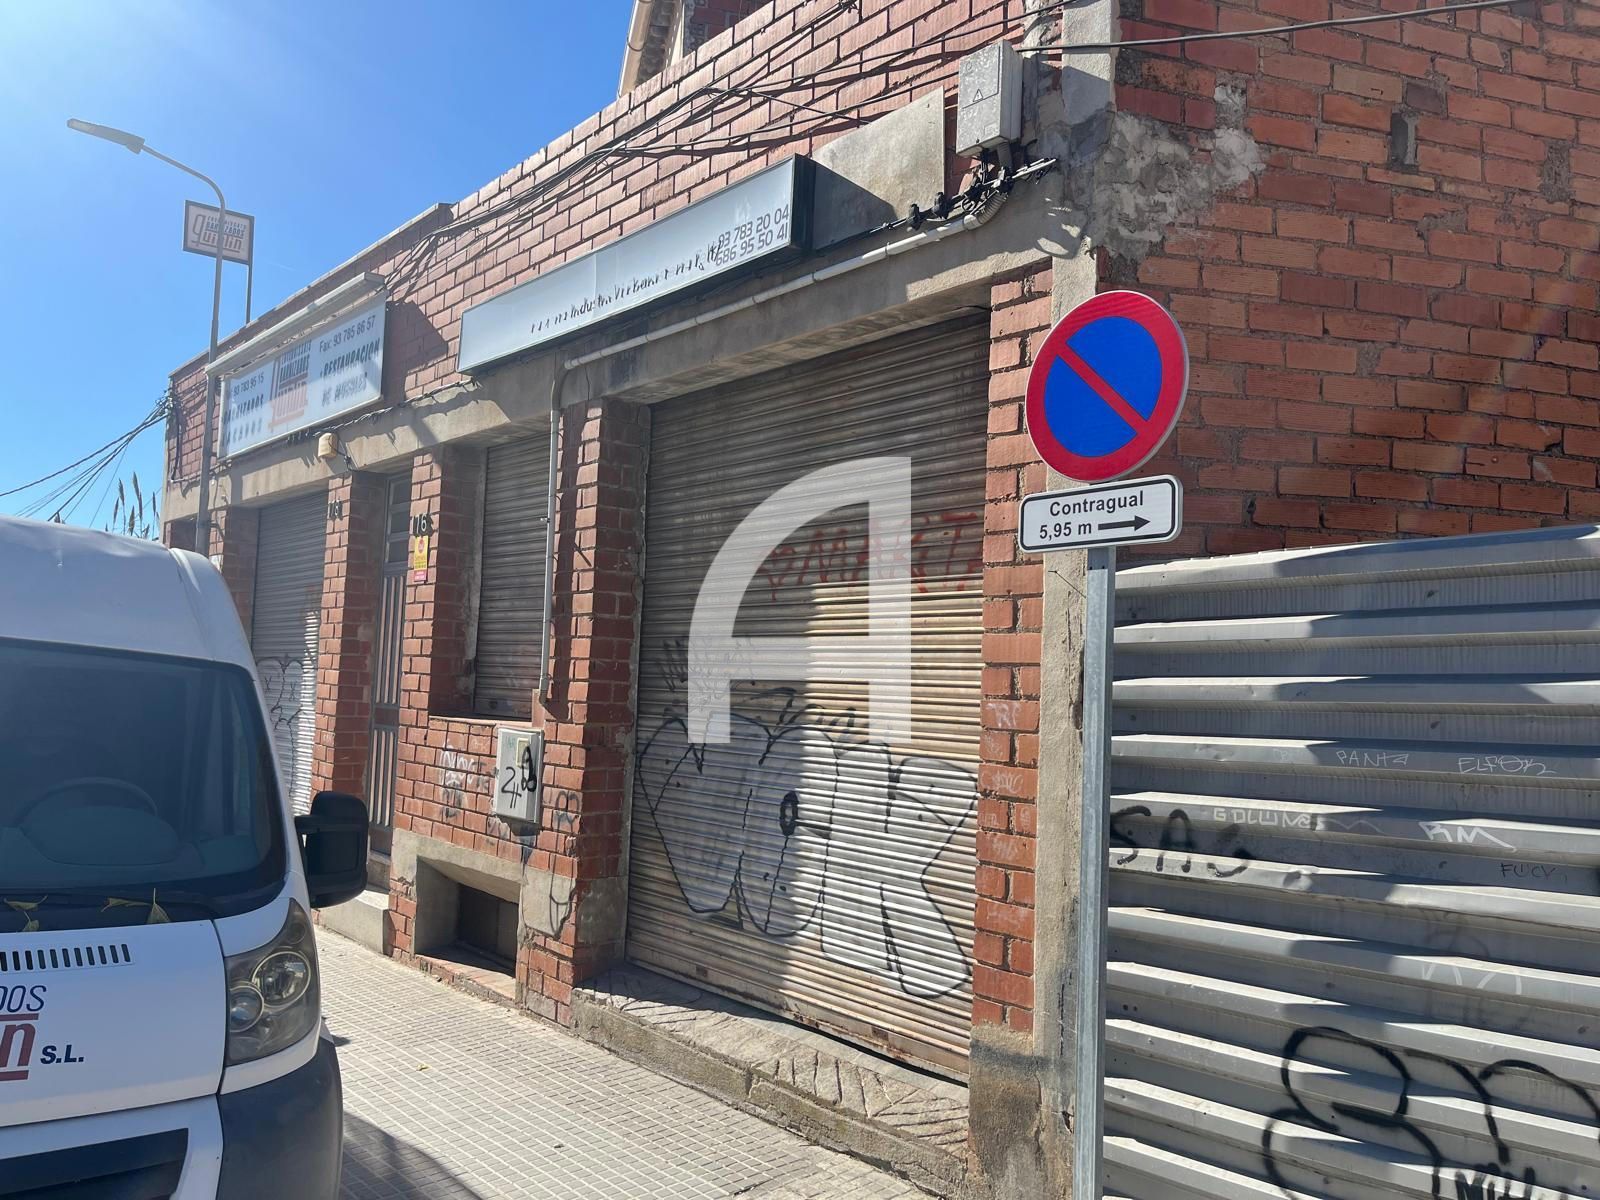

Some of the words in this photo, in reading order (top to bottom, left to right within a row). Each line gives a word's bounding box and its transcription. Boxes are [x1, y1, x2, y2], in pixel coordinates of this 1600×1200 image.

[733, 221, 753, 244] 783
[756, 213, 771, 234] 20
[774, 204, 789, 225] 04
[715, 244, 737, 266] 686
[740, 236, 755, 257] 95
[757, 229, 773, 250] 50
[776, 222, 789, 241] 41
[1050, 489, 1144, 517] Contragual
[1039, 521, 1073, 542] 5,95
[1078, 523, 1092, 536] m
[40, 1043, 85, 1065] S.L.
